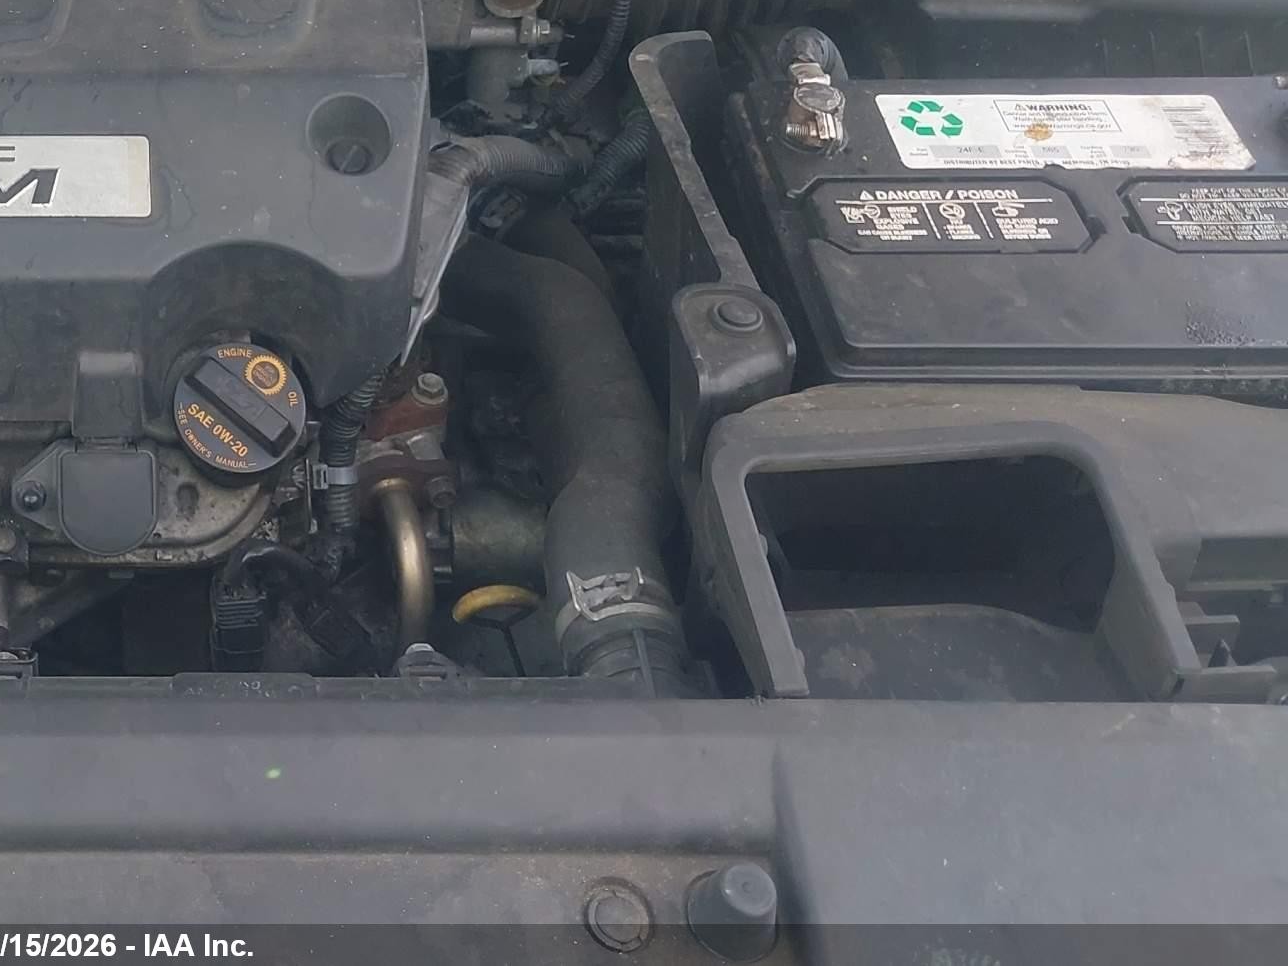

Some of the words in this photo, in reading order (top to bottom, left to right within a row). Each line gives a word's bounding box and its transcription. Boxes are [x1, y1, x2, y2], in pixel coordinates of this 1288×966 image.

[875, 190, 941, 200] DANGER
[957, 190, 1019, 199] POISON
[217, 347, 252, 359] ENGINE
[287, 391, 298, 407] OIL
[187, 403, 214, 428] SAE
[212, 424, 248, 457] 0W-20
[184, 428, 212, 458] OWNER'S
